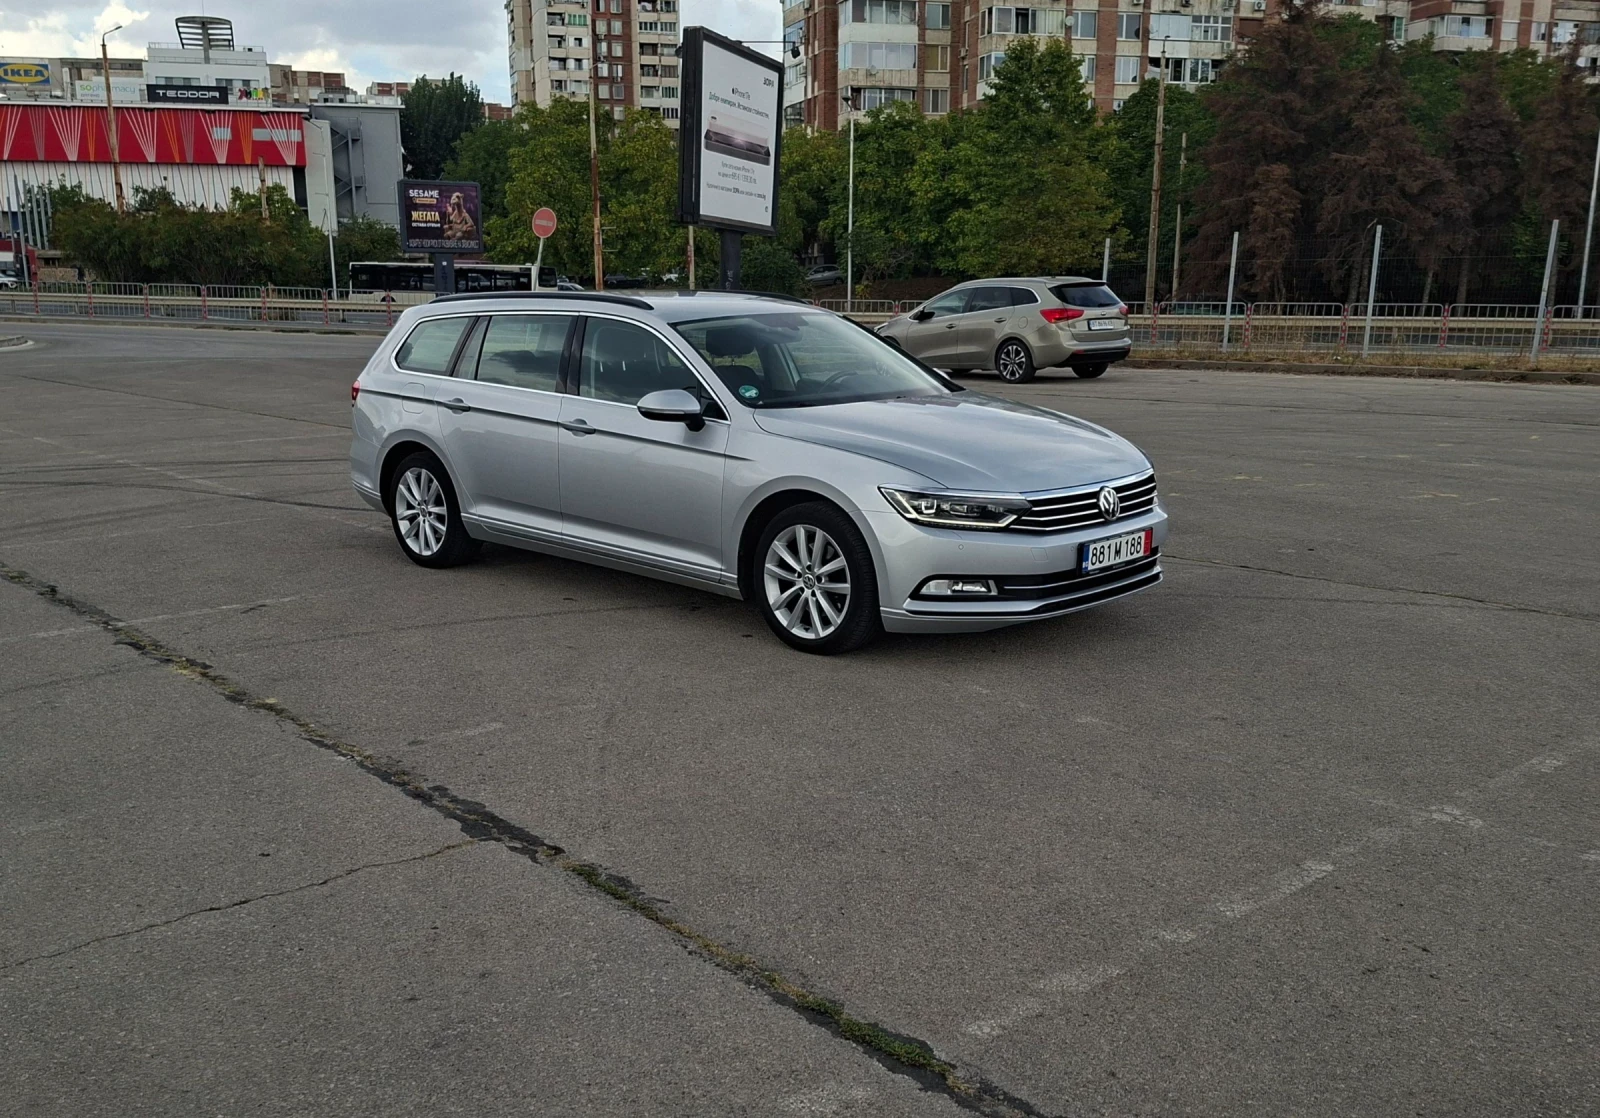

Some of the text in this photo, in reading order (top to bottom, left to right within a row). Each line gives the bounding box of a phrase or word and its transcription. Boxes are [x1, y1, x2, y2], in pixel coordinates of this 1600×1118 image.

[3, 68, 46, 78] IKEA
[80, 84, 136, 94] sophrmacy
[156, 90, 220, 99] TEODOR
[409, 190, 440, 198] SESAME
[412, 211, 440, 222] ЖЕГАТА
